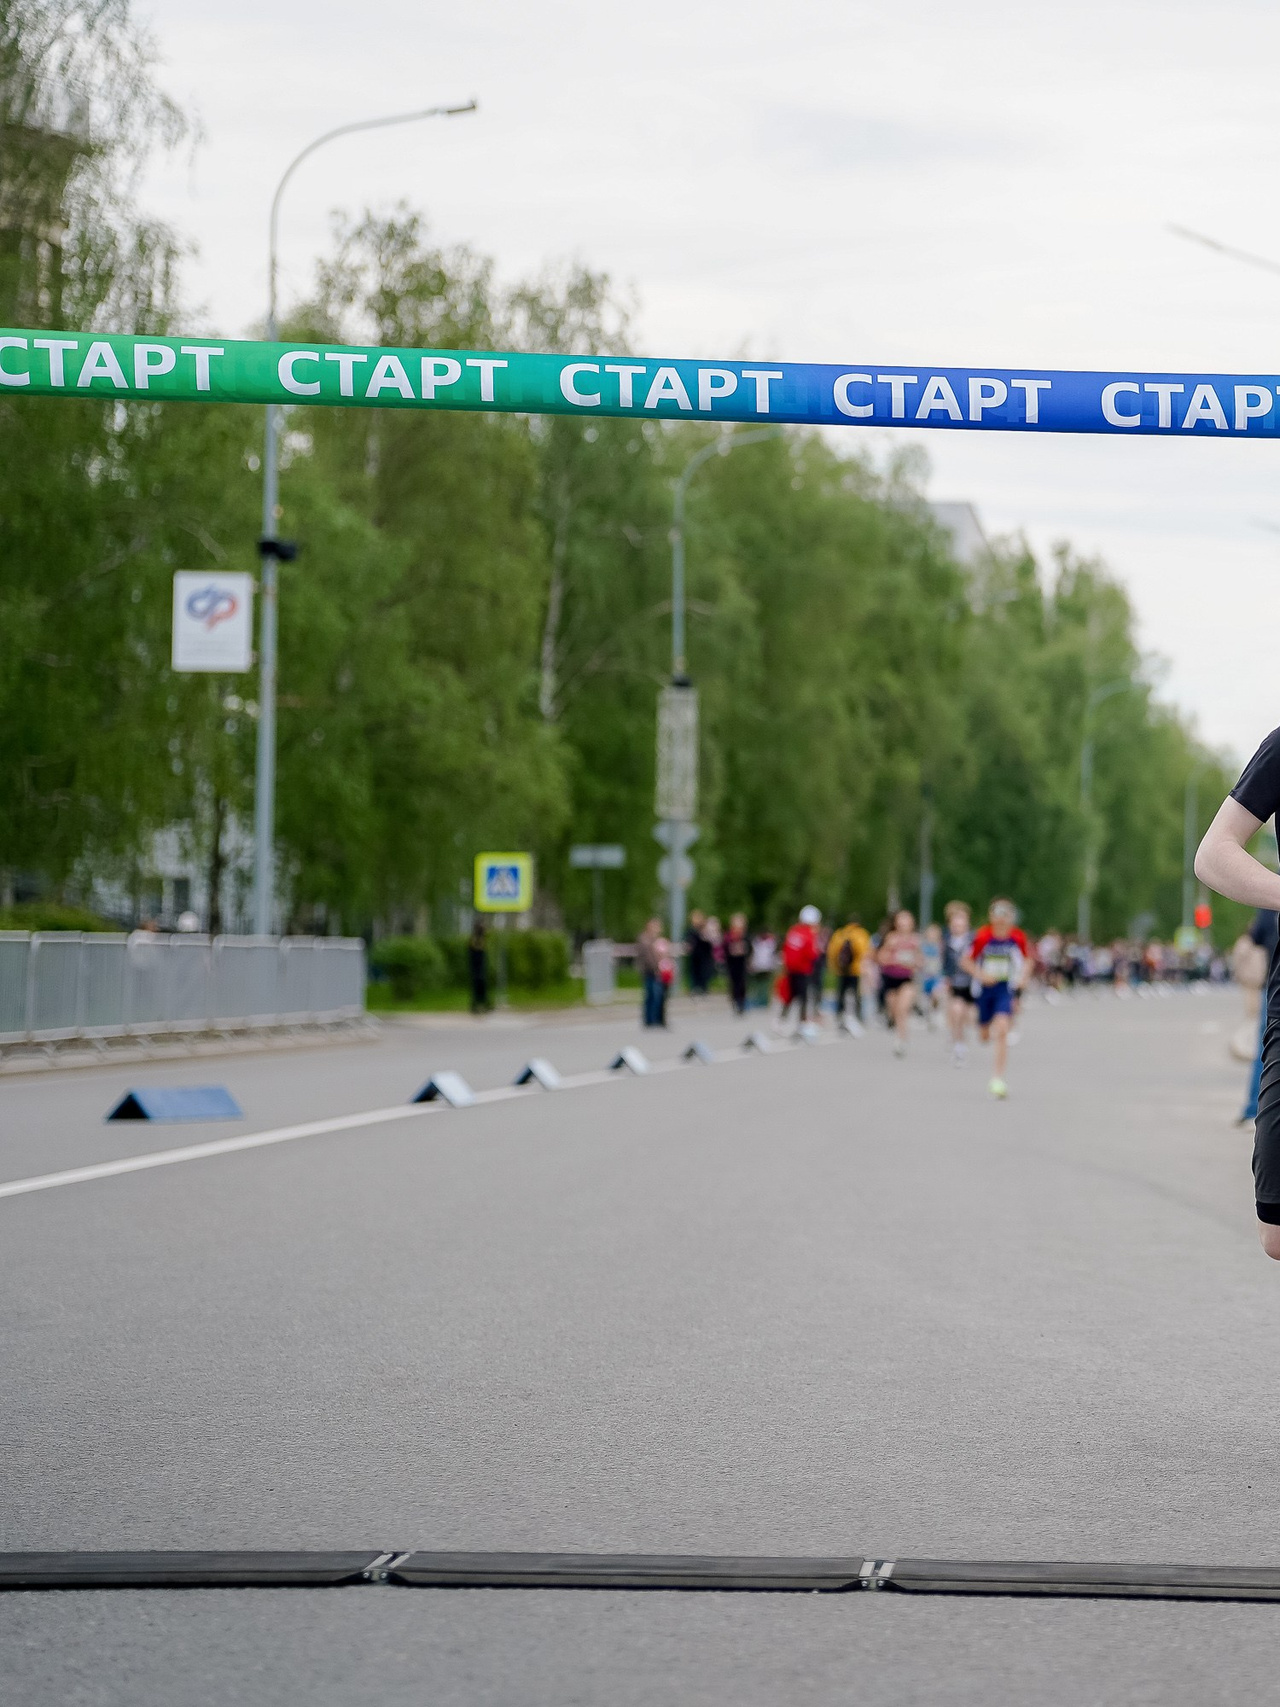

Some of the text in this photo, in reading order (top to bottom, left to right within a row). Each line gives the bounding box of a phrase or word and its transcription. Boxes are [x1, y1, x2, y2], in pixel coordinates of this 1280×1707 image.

[0, 336, 225, 391] СТАРТ
[277, 350, 508, 402] СТАРТ
[559, 363, 783, 413] СТАРТ
[833, 373, 1052, 424] СТАРТ
